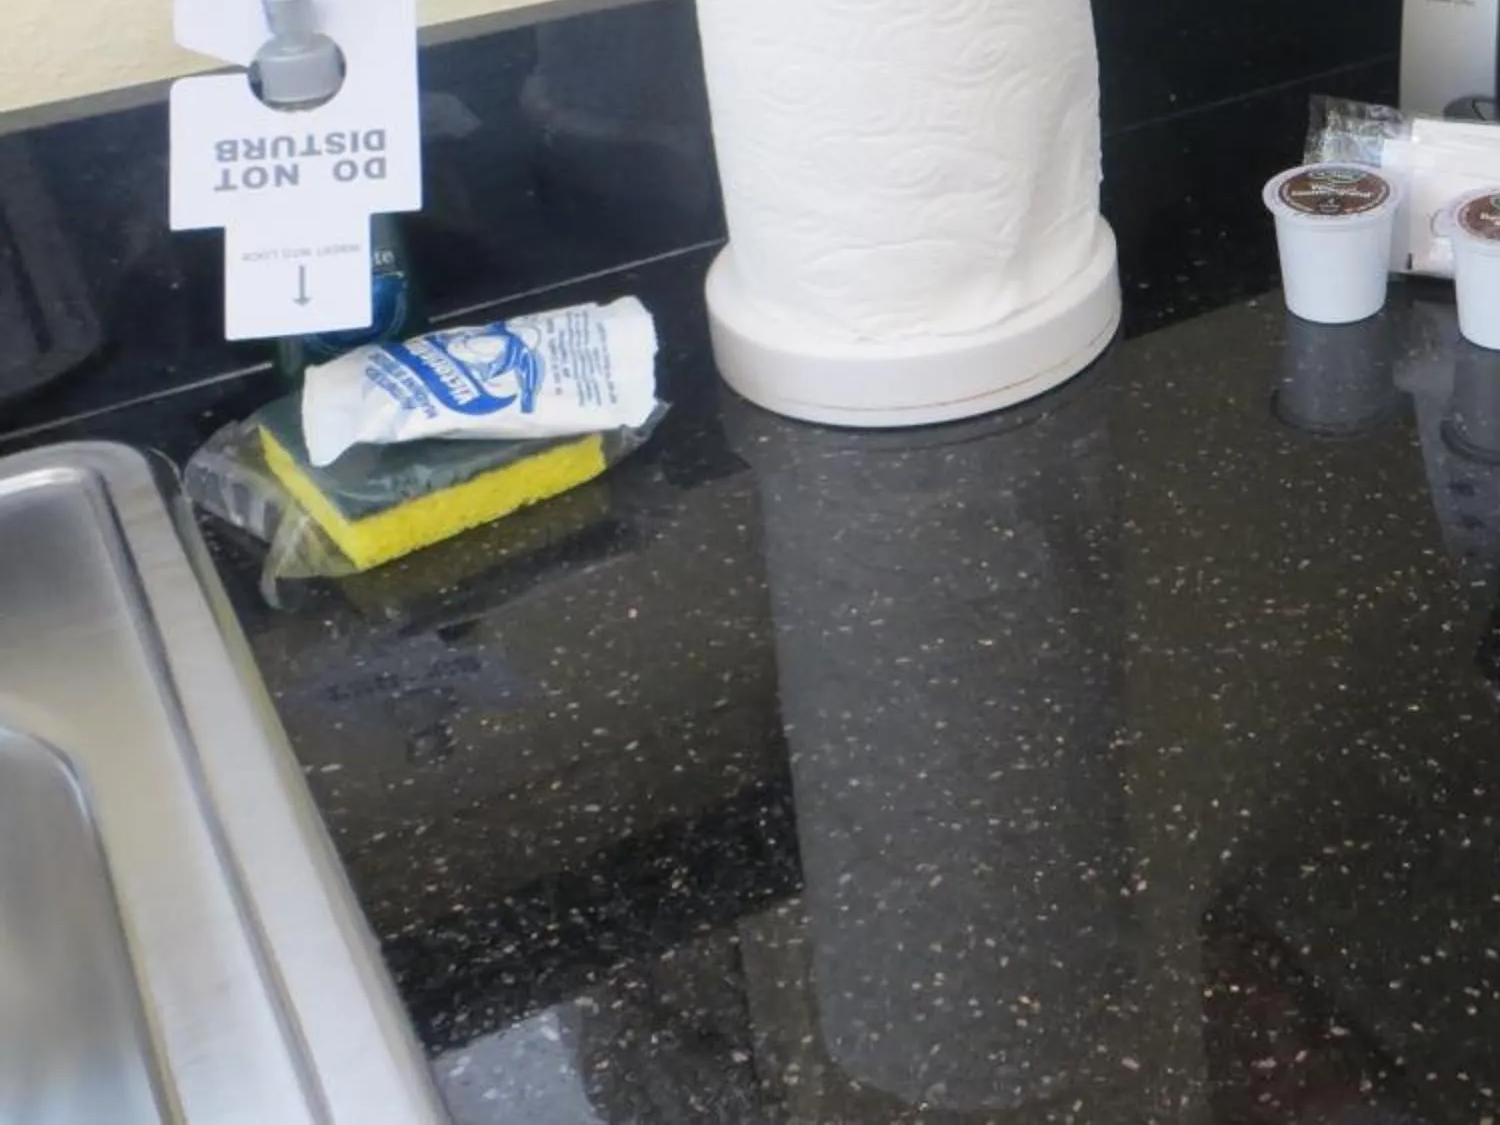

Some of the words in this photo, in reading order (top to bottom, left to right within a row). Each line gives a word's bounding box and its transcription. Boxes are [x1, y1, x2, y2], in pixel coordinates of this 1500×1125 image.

[214, 129, 386, 163] DISTURB
[213, 163, 300, 192] NOT
[332, 157, 387, 183] DO
